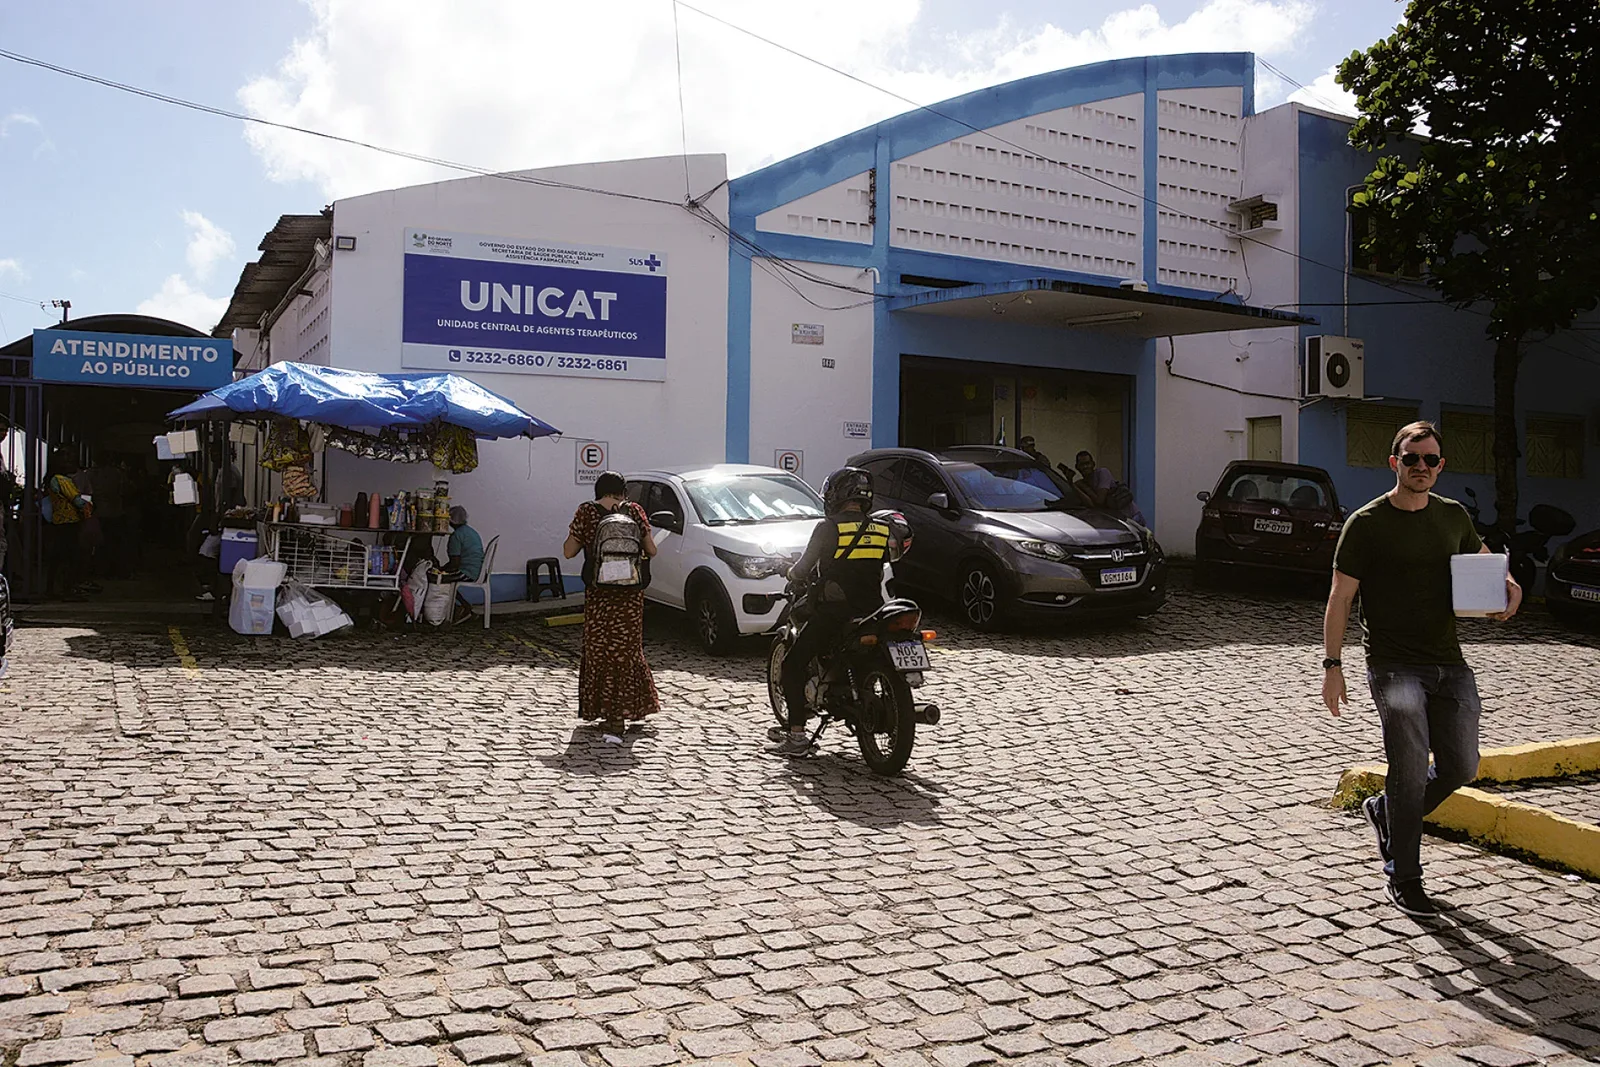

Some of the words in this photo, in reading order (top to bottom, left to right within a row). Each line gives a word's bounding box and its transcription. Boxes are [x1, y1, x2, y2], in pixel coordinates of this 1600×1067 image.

[506, 254, 539, 262] ASSISTÊNCIA
[629, 257, 644, 266] SUS
[460, 280, 618, 321] UNICAT
[437, 319, 479, 330] UNIDADE
[481, 322, 521, 333] CENTRAL
[523, 324, 534, 334] DE
[536, 326, 575, 336] AGENTES
[577, 328, 638, 340] TERAPÊUTICOS
[50, 339, 218, 362] ATENDIMENTO
[80, 361, 107, 374] AO
[112, 360, 190, 378] PÚBLICO
[466, 351, 544, 367] 3232-6860
[557, 356, 628, 372] 3232-6861
[586, 448, 598, 463] E
[785, 456, 794, 471] E
[896, 646, 918, 656] NOC
[896, 656, 923, 666] 7F57
